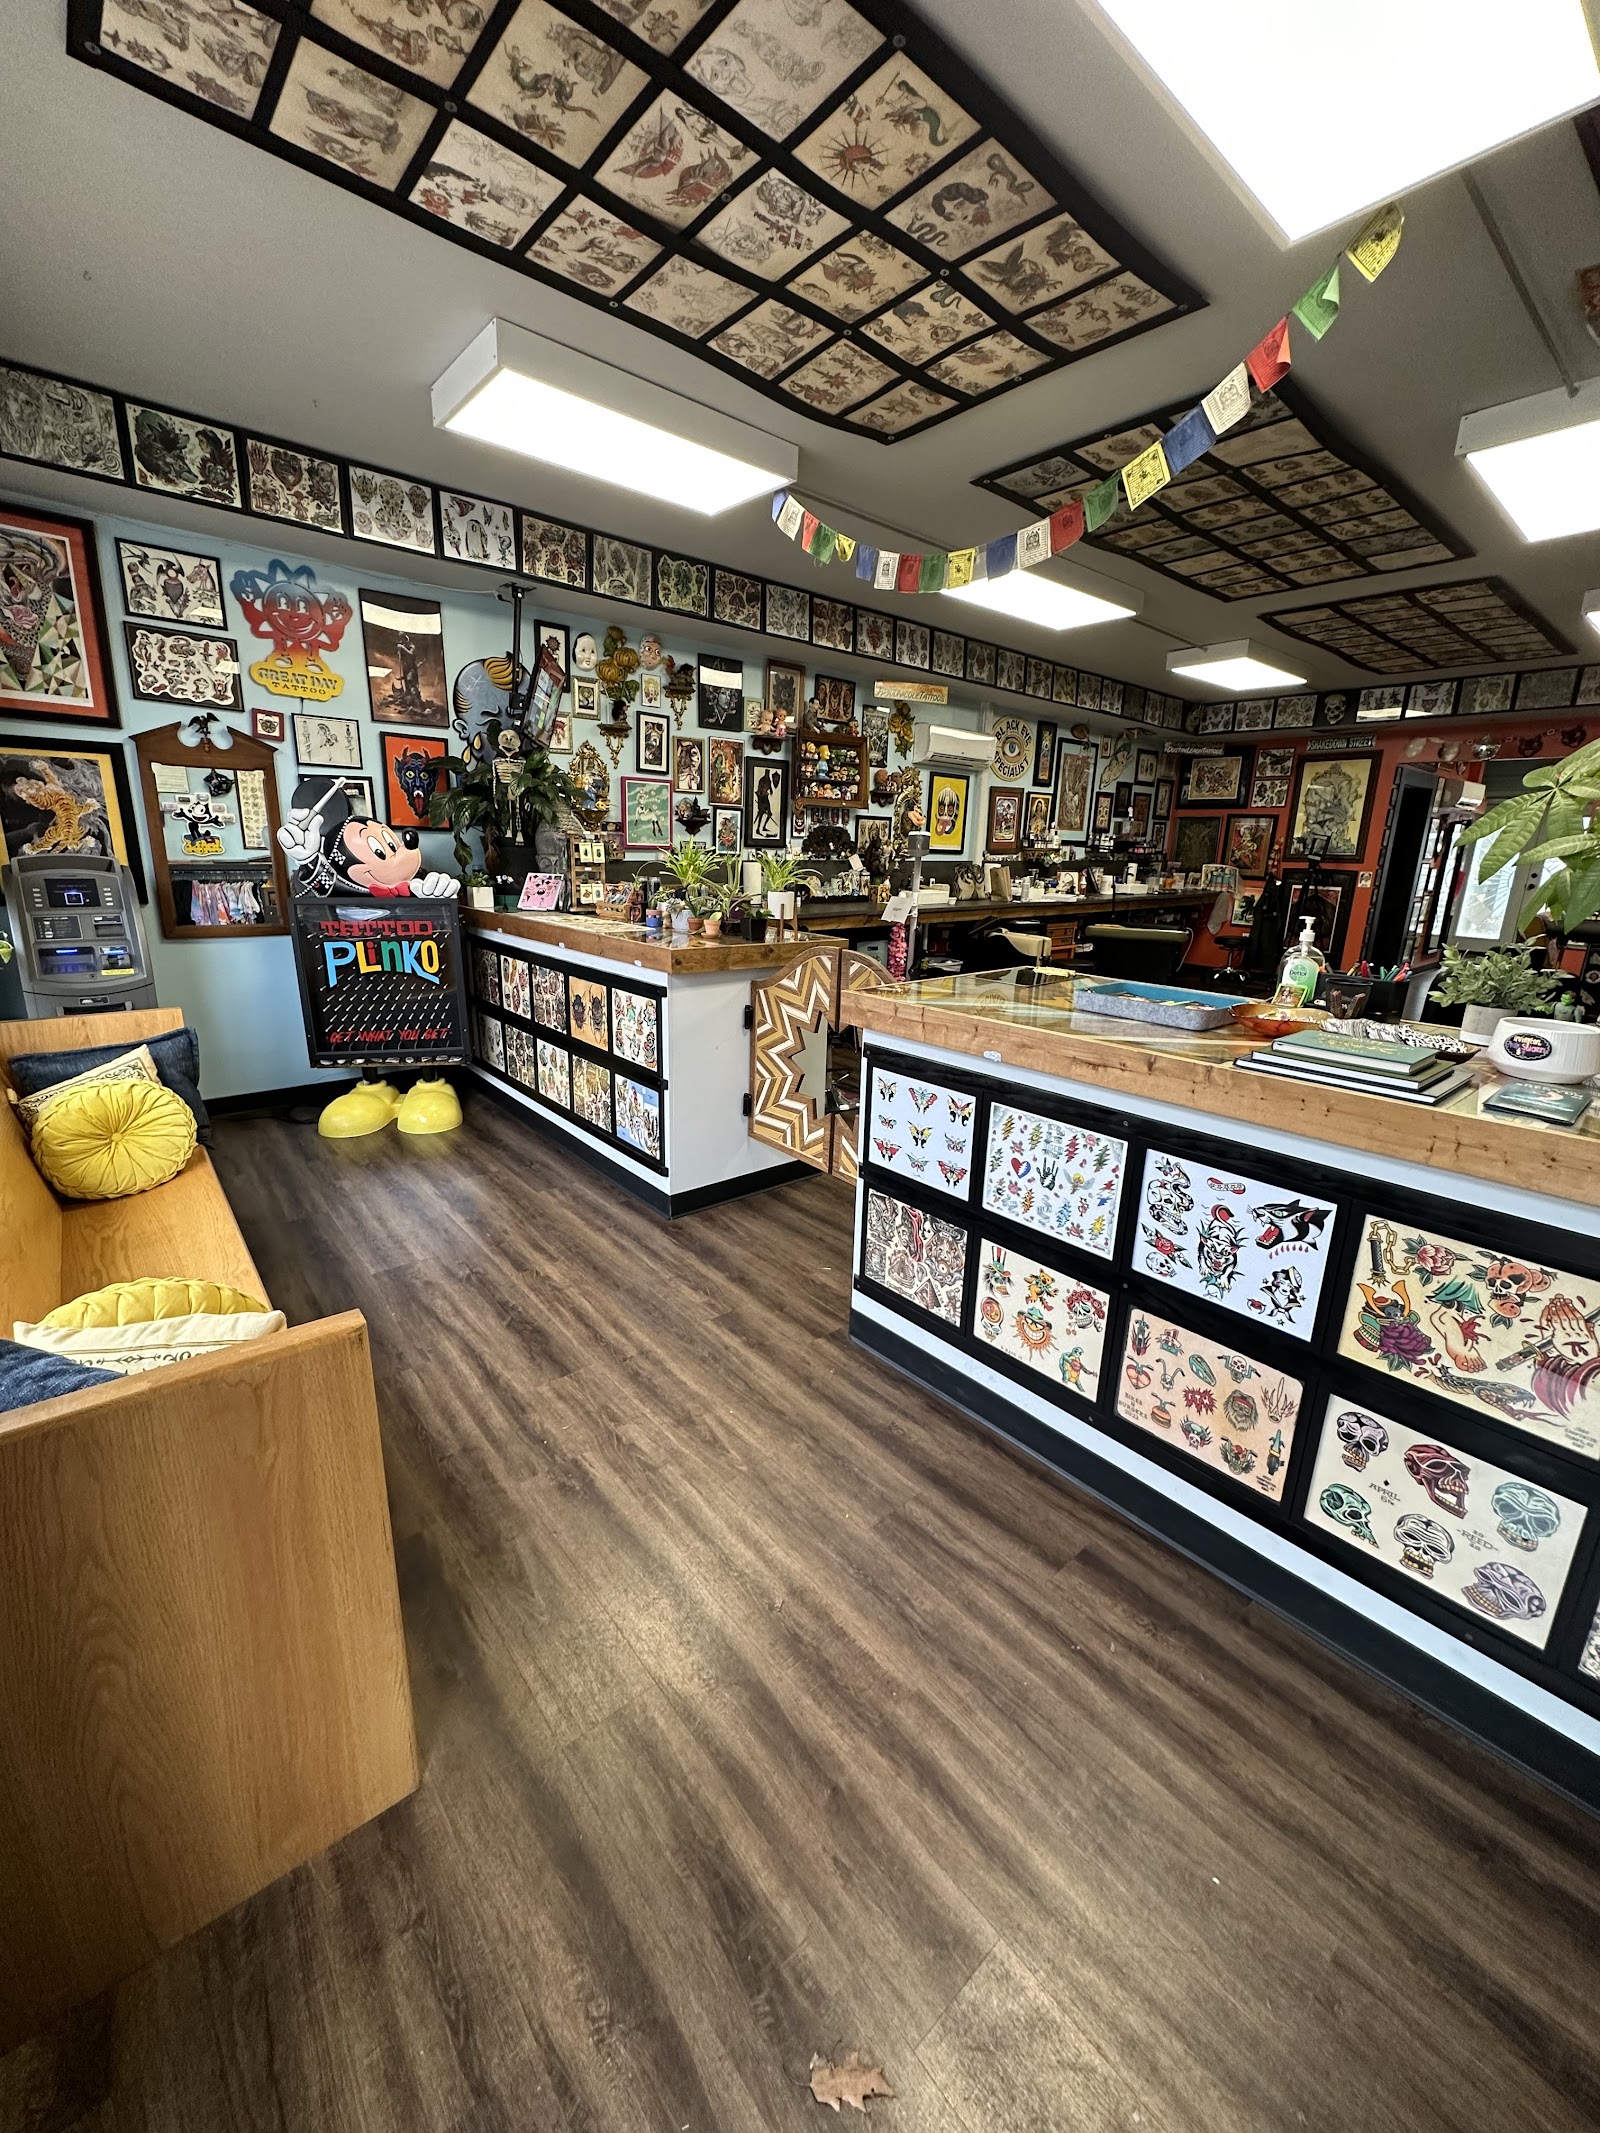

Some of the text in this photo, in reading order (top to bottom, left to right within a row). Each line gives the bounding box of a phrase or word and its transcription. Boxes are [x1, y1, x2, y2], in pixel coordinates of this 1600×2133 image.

[258, 667, 338, 690] GREAT DAY
[272, 681, 327, 695] TATTOO
[995, 719, 1032, 746] BLACK EYE
[1310, 736, 1373, 751] SHAKEDOWN STREET
[994, 750, 1029, 778] SPECIALIST
[320, 920, 434, 937] TATTOO
[1289, 968, 1307, 977] Dettol
[357, 1029, 393, 1042] WHAT
[399, 1029, 421, 1042] YOU
[424, 1028, 450, 1040] GET
[1125, 1392, 1143, 1406] BIKES
[1119, 1400, 1148, 1420] BURGERS
[1369, 1483, 1401, 1502] APRIL
